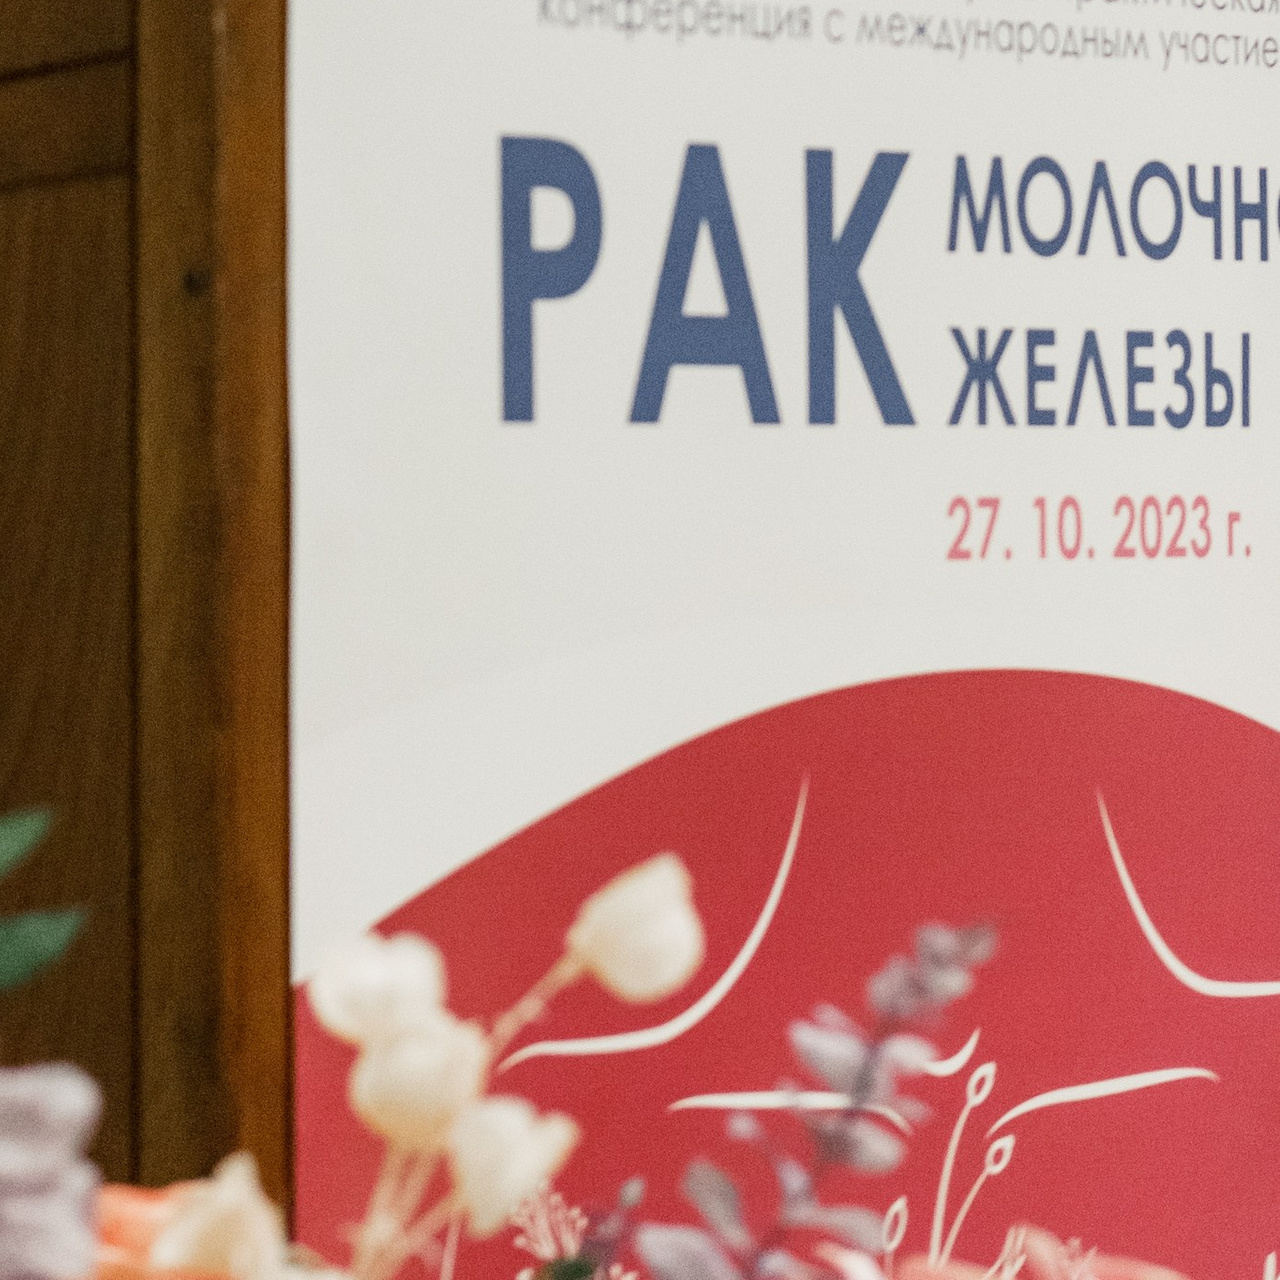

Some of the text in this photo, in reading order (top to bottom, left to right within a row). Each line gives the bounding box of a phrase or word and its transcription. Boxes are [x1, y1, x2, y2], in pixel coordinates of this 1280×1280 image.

[823, 6, 846, 46] с
[855, 11, 1150, 64] международным
[946, 153, 1280, 263] МОЛОЧН
[498, 133, 917, 428] РАК
[947, 326, 1253, 430] ЖЕЛЕЗЫ
[1111, 494, 1213, 561] 2023
[1225, 509, 1254, 558] г.
